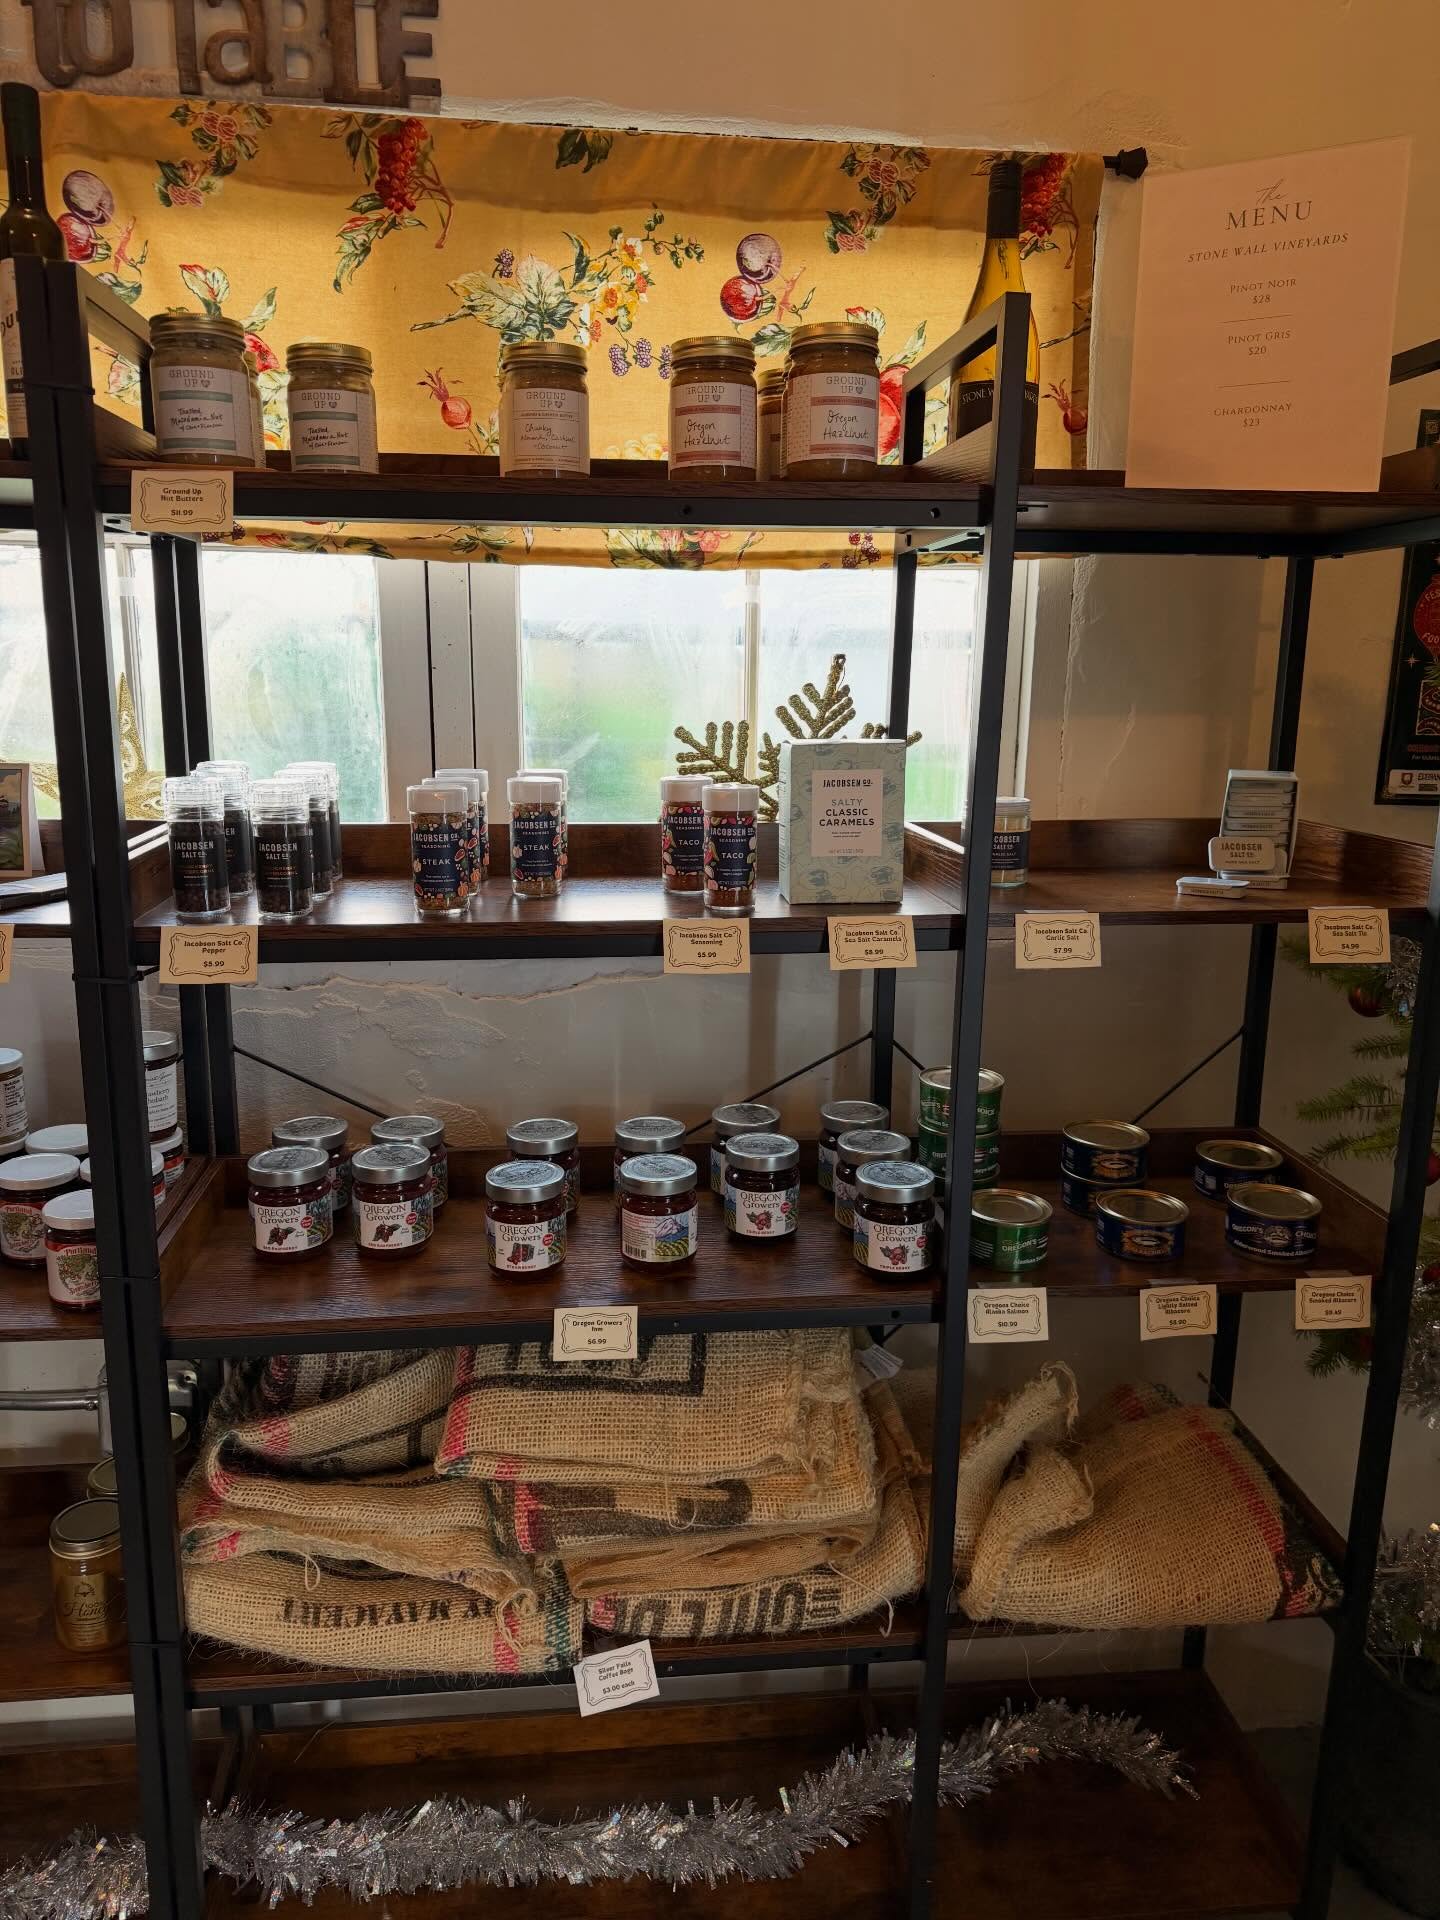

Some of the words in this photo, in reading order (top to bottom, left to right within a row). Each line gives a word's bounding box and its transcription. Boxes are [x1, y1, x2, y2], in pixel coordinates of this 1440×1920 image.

[1256, 179, 1287, 205] The
[1225, 201, 1312, 230] MENU
[1187, 247, 1229, 263] STONE
[1234, 242, 1267, 257] WALL
[1273, 232, 1349, 252] VINEYARDS
[1230, 281, 1264, 293] PINOT
[1268, 278, 1297, 289] NOIR
[1252, 294, 1271, 304] $28
[1227, 334, 1262, 345] PINOT
[1265, 330, 1291, 341] GRIS
[1248, 346, 1267, 356] $20
[168, 369, 216, 380] GROUND
[184, 378, 199, 388] UP
[826, 375, 867, 386] GROUND
[841, 385, 854, 394] UP
[301, 391, 341, 401] GROUND
[526, 391, 566, 401] GROUND
[962, 387, 986, 405] STONE
[314, 400, 326, 409] UP
[540, 400, 553, 408] UP
[1213, 403, 1292, 417] CHARDONNAY
[827, 409, 858, 431] Oregon
[687, 419, 715, 438] Oregon
[823, 427, 870, 440] Hazelnut
[683, 434, 731, 449] Hazelnut
[162, 487, 189, 496] Ground
[191, 488, 202, 498] Up
[175, 495, 204, 503] Butters
[823, 779, 861, 788] JACOBSEN
[831, 798, 864, 807] SALTY
[825, 808, 869, 817] CLASSIC
[514, 820, 549, 829] JACOBSEN
[667, 816, 703, 824] JACOBSEN
[819, 818, 876, 827] CARAMELS
[710, 827, 747, 837] JACOBSEN
[413, 833, 449, 842] JACOBSEN
[994, 835, 1020, 843] COBSEN
[174, 840, 214, 850] JACOBSEN
[258, 842, 298, 852] JACOBSEN
[1221, 842, 1263, 852] JACOBSEN
[422, 858, 451, 866] STEAK
[874, 929, 888, 937] Salt
[1064, 927, 1078, 935] Salt
[690, 938, 723, 947] Seasoning
[871, 935, 902, 943] Caramels
[1045, 934, 1066, 942] Garlic
[202, 947, 226, 955] Pepper
[203, 960, 225, 968] $5.99
[740, 1191, 781, 1203] OREGON
[363, 1203, 406, 1215] OREGON
[742, 1200, 780, 1209] Growers
[257, 1207, 300, 1218] OREGON
[366, 1212, 405, 1221] Growers
[260, 1215, 300, 1225] Growers
[499, 1224, 543, 1235] OREGON
[873, 1223, 918, 1235] OREGON
[502, 1232, 542, 1242] Growers
[876, 1232, 916, 1242] Growers
[1001, 1238, 1037, 1252] OREGON'S
[598, 1665, 615, 1675] Silver
[615, 1661, 632, 1670] Falls
[598, 1671, 619, 1681] Coffee
[619, 1667, 634, 1676] Bags
[602, 1684, 621, 1695] $3.00
[621, 1680, 635, 1689] each
